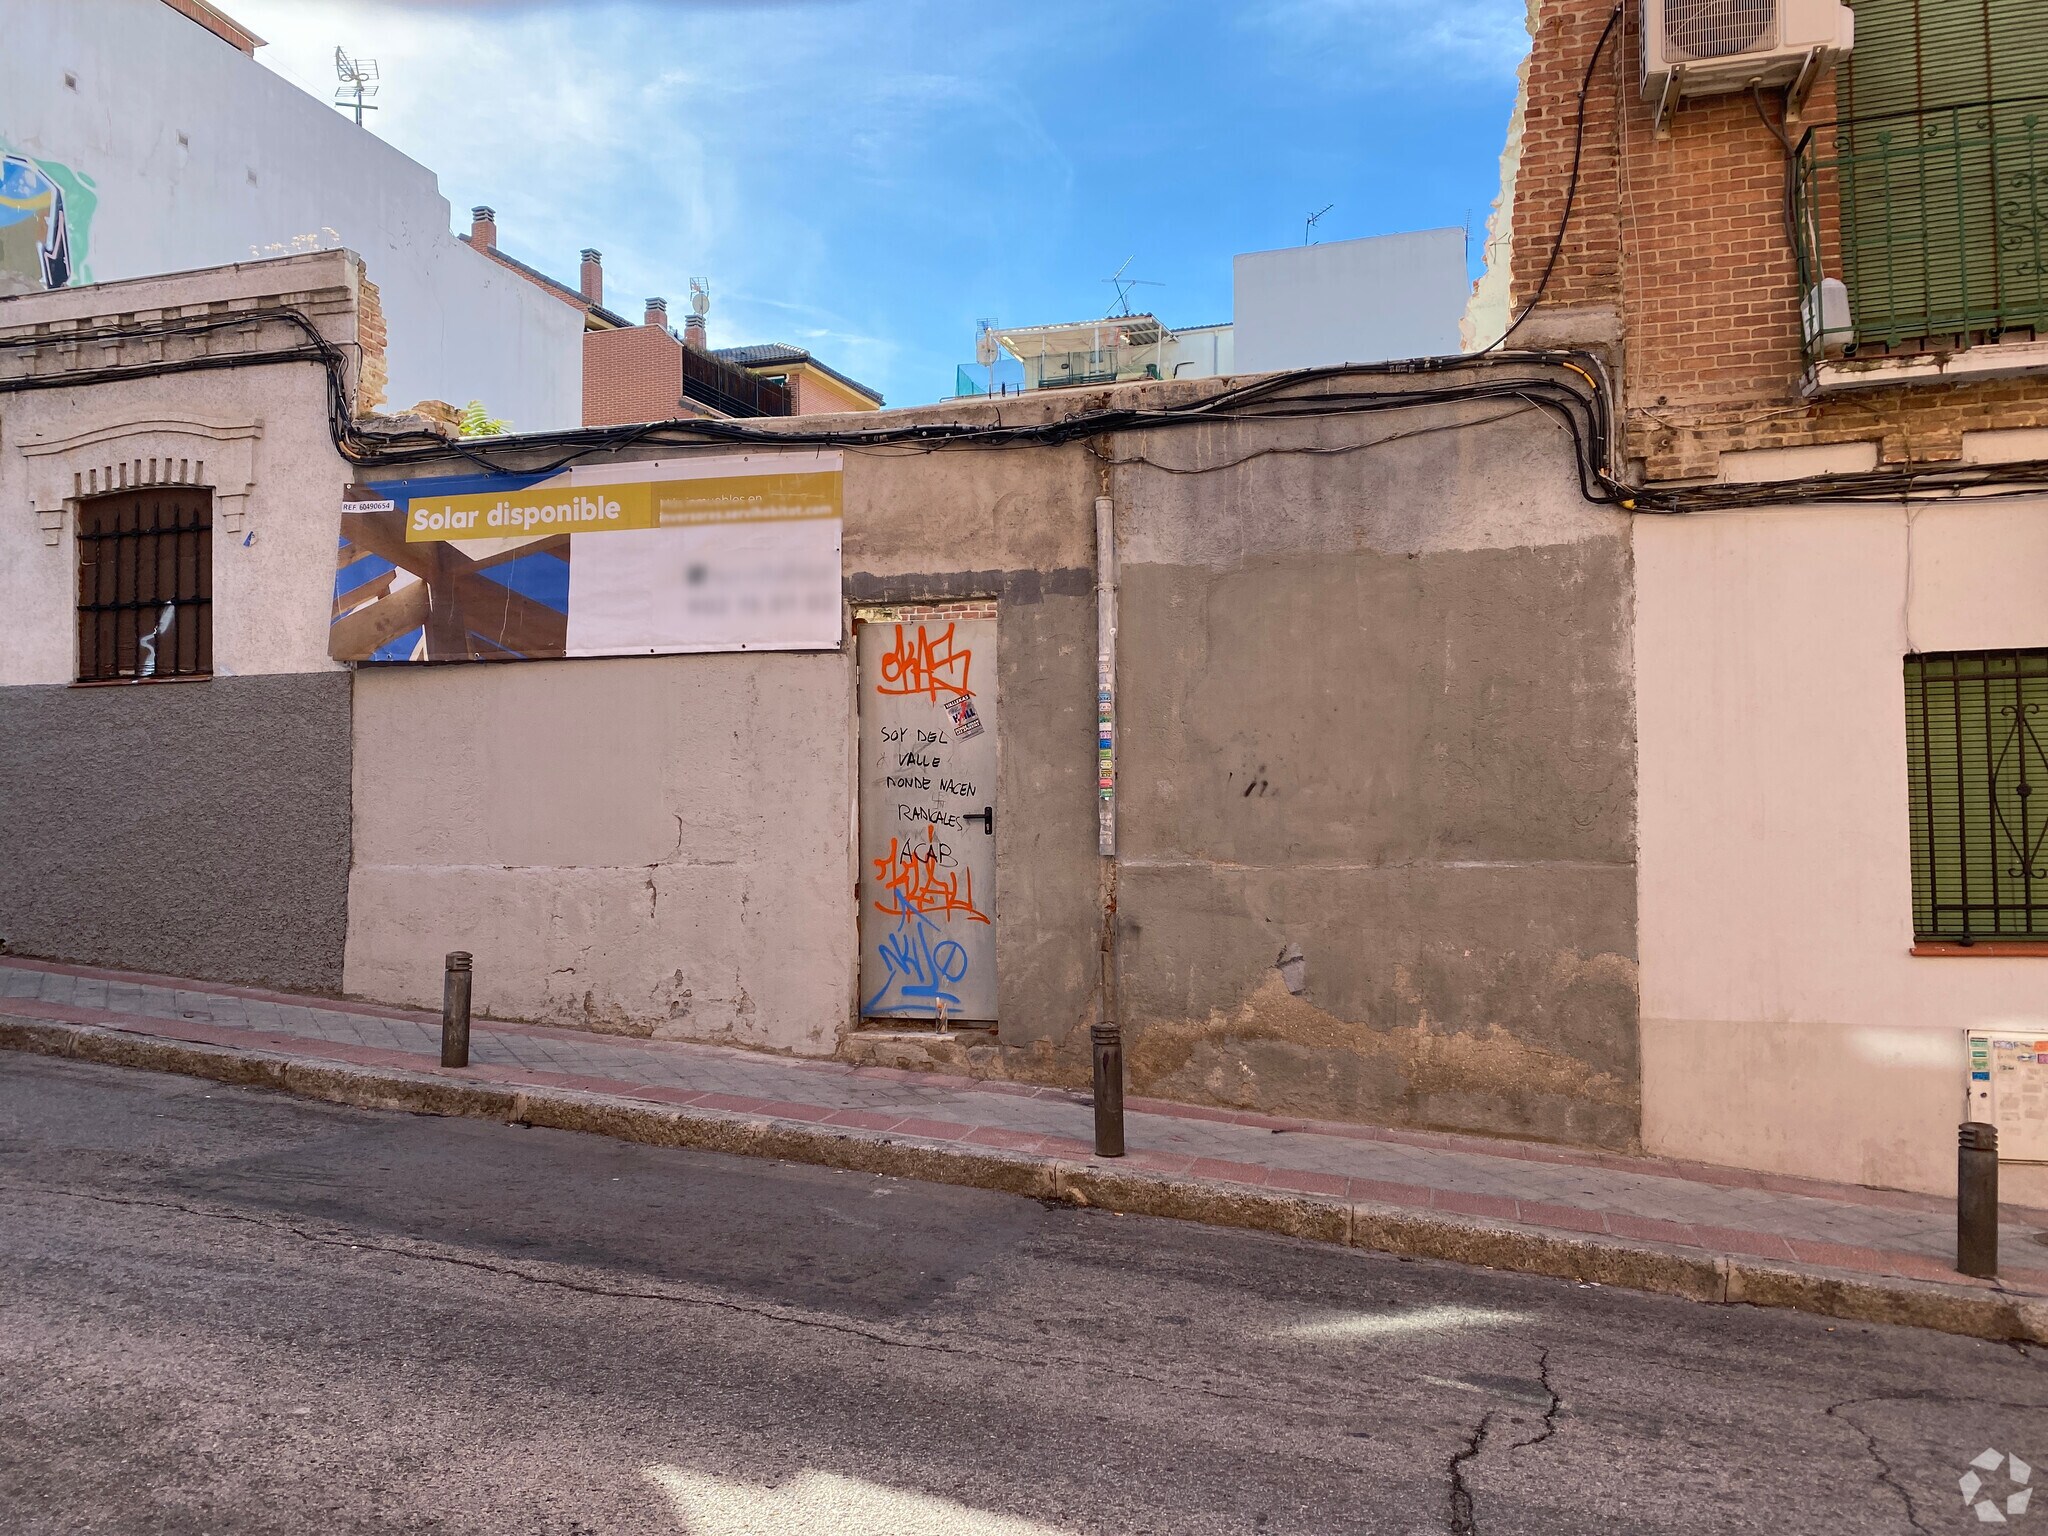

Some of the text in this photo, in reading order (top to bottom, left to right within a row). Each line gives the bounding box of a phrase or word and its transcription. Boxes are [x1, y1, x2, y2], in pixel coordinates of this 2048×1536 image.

[359, 502, 390, 511] 60490654
[413, 496, 621, 531] Solar disponible
[881, 726, 908, 742] SOY
[917, 729, 947, 744] DEL
[899, 752, 940, 768] VALLE
[940, 779, 976, 796] NACEN
[900, 838, 959, 867] ACAB
